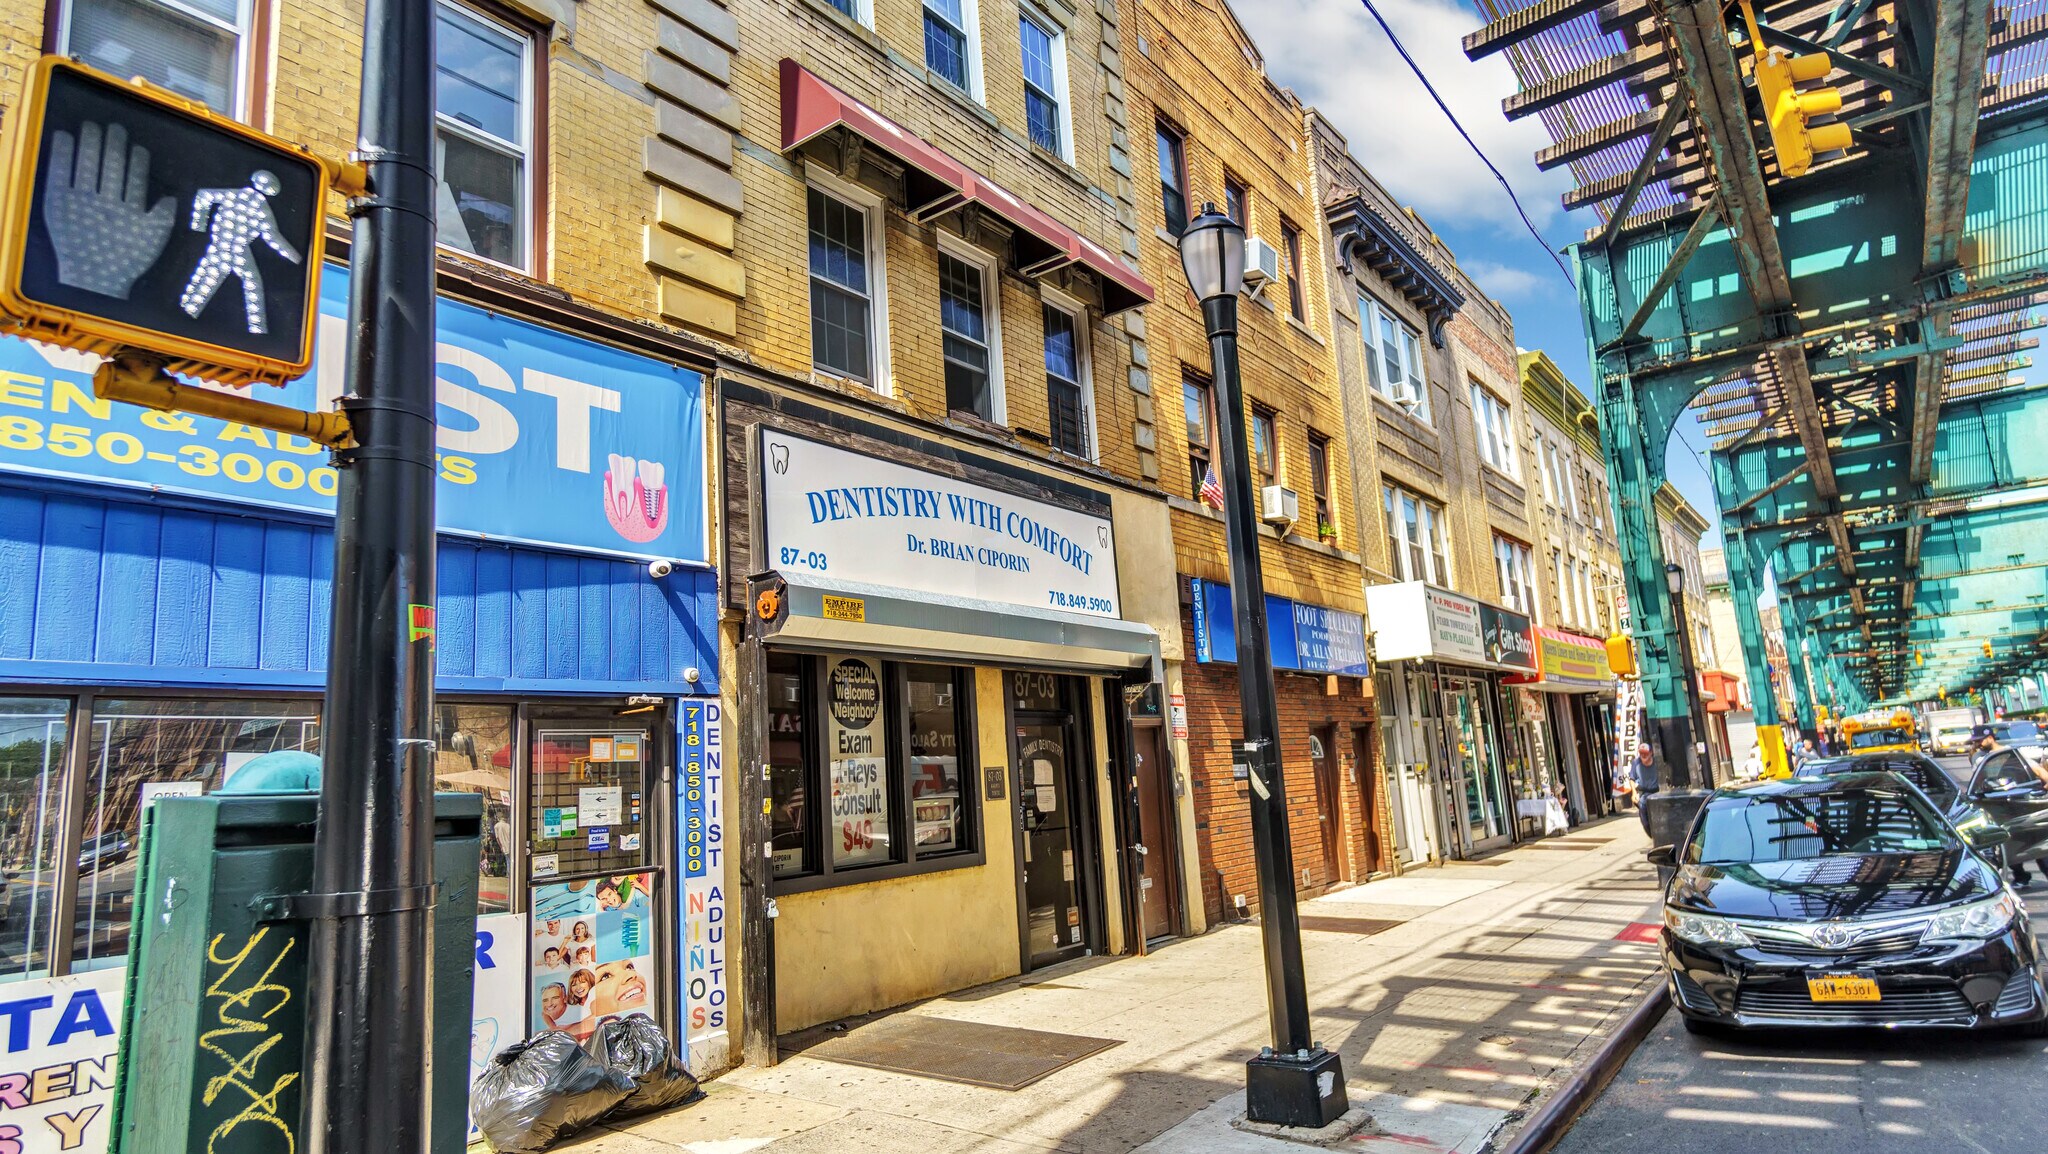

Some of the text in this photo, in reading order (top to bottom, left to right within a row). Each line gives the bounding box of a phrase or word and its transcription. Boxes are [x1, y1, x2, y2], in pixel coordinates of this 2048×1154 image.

[805, 486, 1093, 576] DENTISTRY WITH COMFORT
[781, 546, 827, 571] 87-03
[907, 533, 1030, 573] Dr. BRIAN CIPORIN
[825, 598, 863, 609] EMPIRE
[1049, 590, 1112, 613] 718.849.5900
[1193, 583, 1205, 647] DENTIST
[1295, 604, 1362, 635] FOOT SPECIALIST
[1500, 628, 1532, 659] Gift Shop
[834, 665, 876, 684] SPECIAL
[1014, 672, 1055, 699] 87-03
[835, 683, 875, 701] Welcome
[1623, 679, 1637, 767] BARBER
[838, 730, 872, 754] Exam
[1022, 739, 1064, 759] FAMILY DENTISTRY
[685, 707, 702, 872] 718-850-3000
[706, 704, 721, 867] DENTIST
[833, 788, 882, 817] Consult
[842, 819, 874, 853] $49
[689, 892, 706, 1030] NIÑOS
[707, 886, 726, 1028] ADULTOS
[44, 1104, 104, 1150] Y
